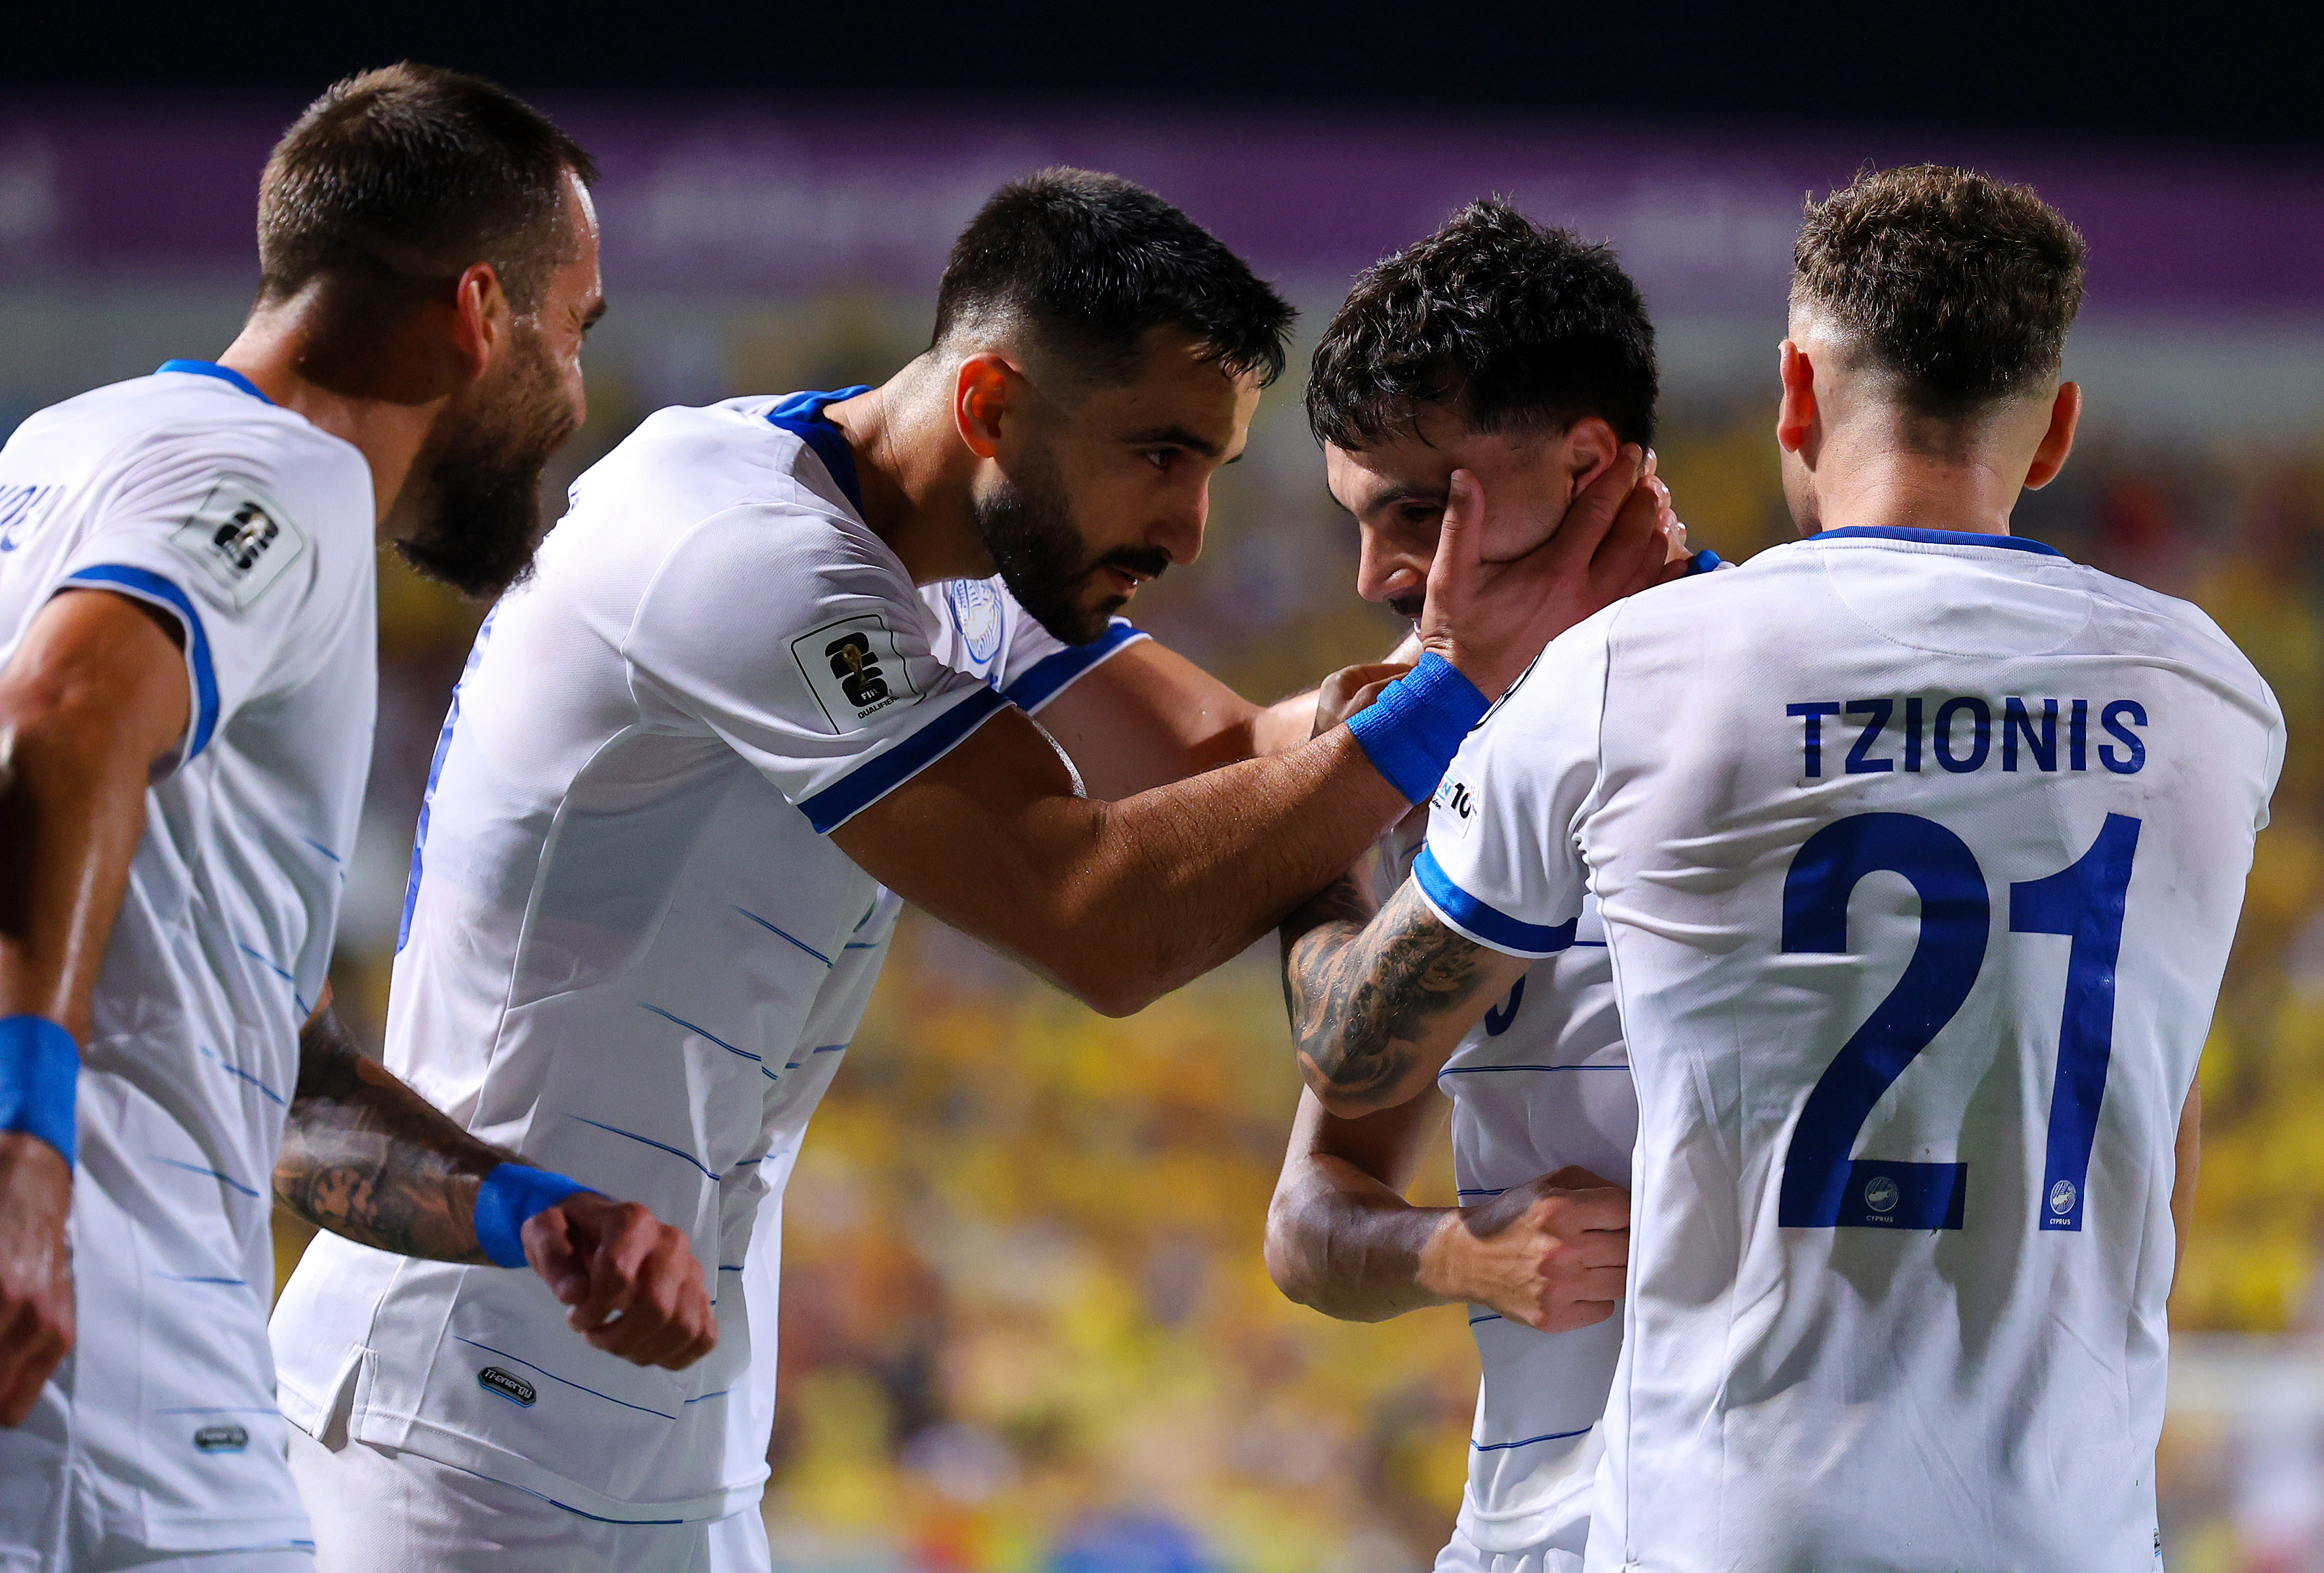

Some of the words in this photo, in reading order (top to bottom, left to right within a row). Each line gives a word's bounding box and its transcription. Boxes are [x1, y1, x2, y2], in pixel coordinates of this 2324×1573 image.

[857, 696, 900, 719] QUALIFIER
[1785, 697, 2149, 778] TZIONIS
[1778, 812, 2142, 1231] 21
[485, 1368, 533, 1399] Ti-energy
